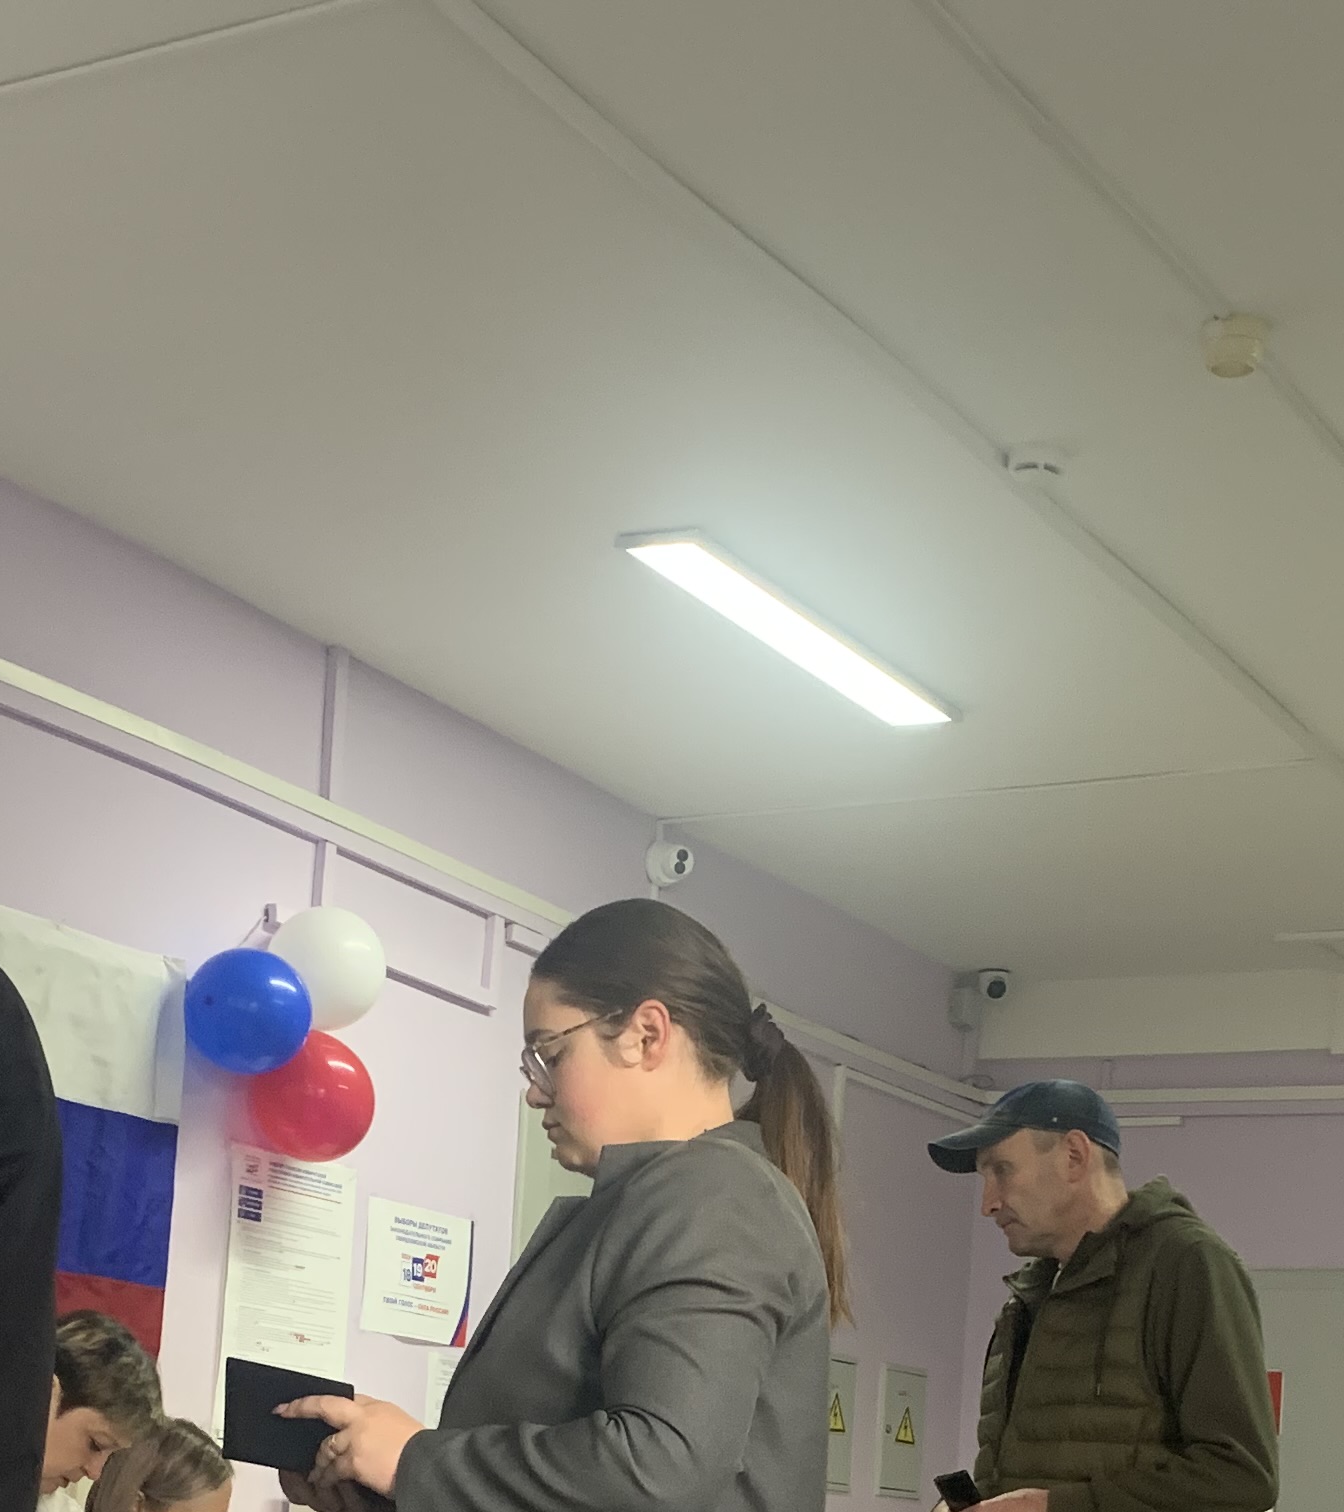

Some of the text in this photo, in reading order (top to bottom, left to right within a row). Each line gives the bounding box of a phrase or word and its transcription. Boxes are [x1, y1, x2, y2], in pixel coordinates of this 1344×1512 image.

[402, 1259, 436, 1282] 18 19 20
